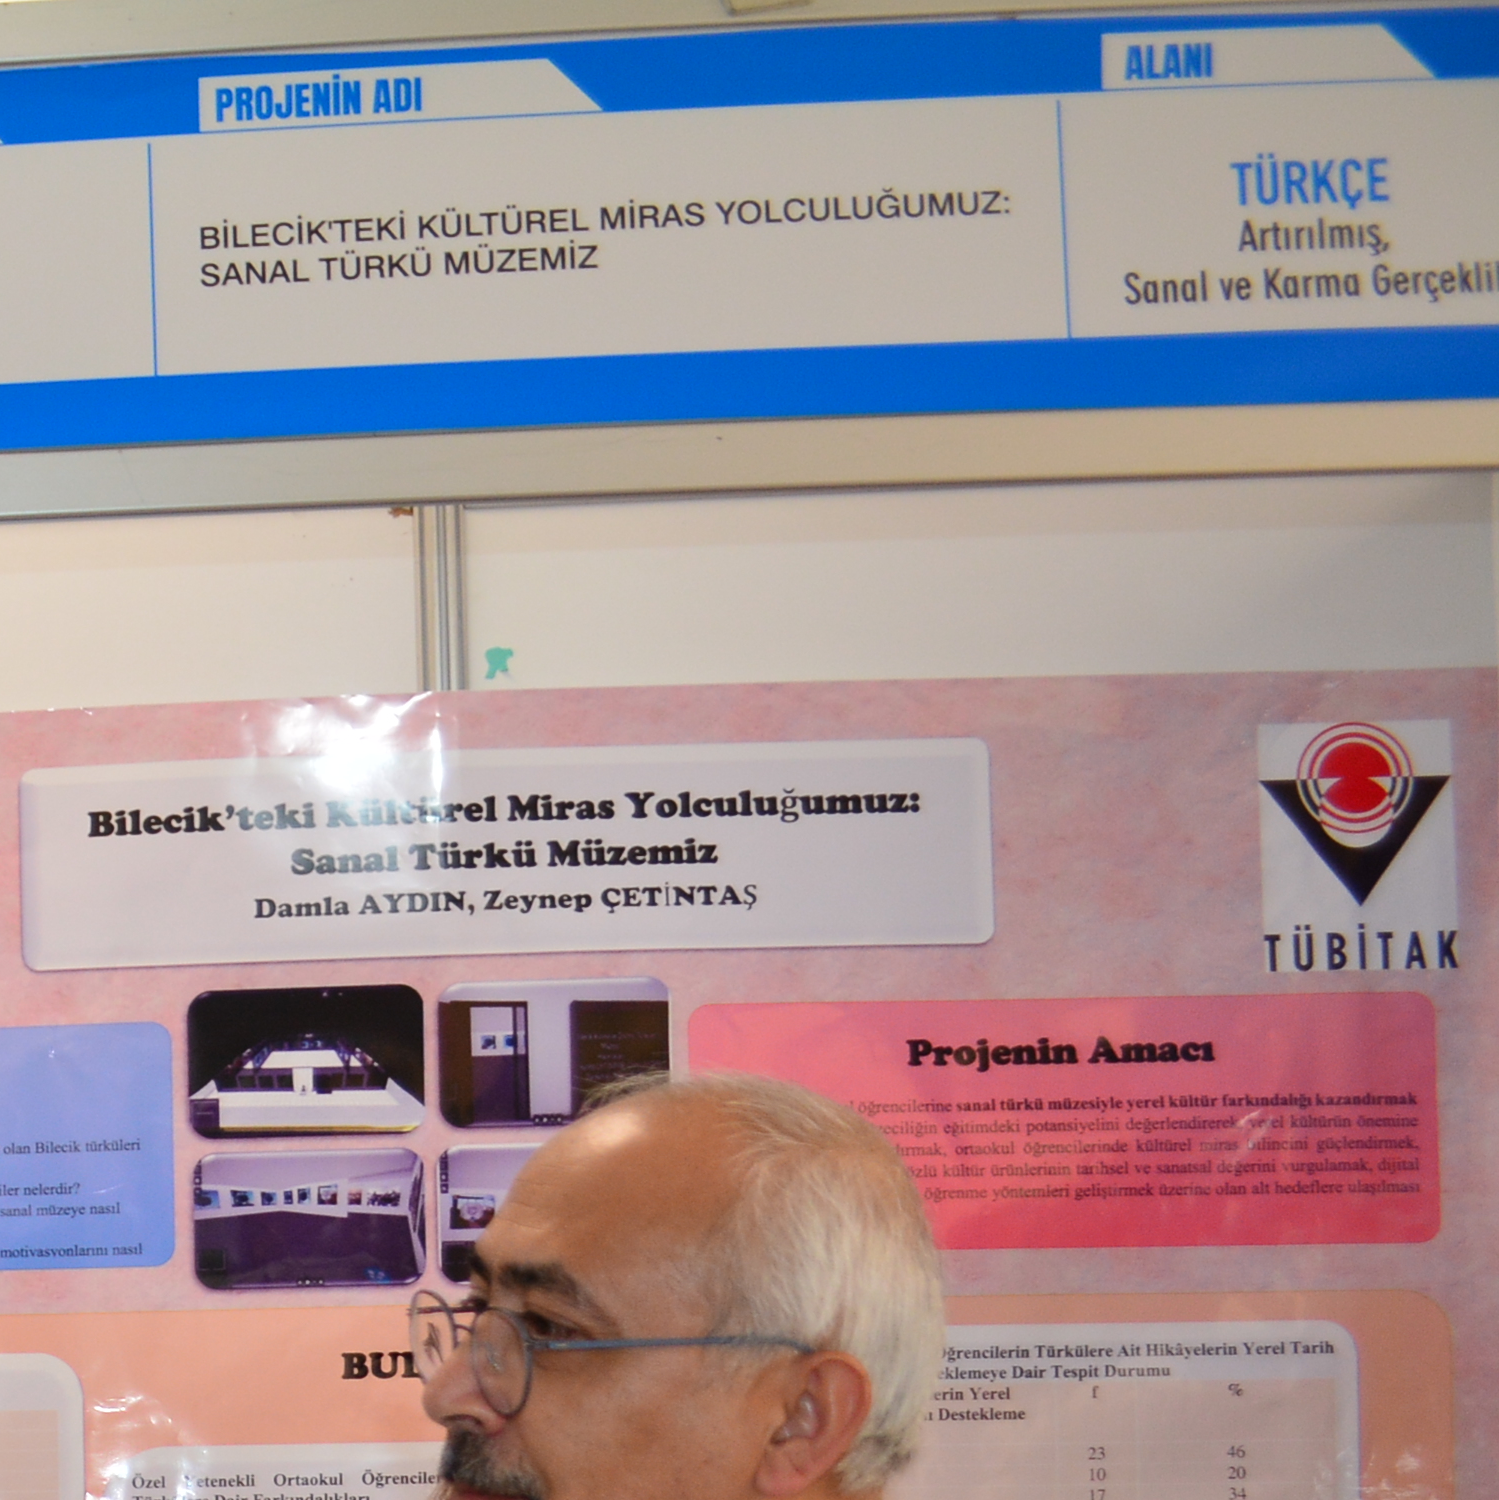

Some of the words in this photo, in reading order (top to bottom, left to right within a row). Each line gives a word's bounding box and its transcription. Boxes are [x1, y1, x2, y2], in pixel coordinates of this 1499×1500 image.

[1126, 43, 1213, 80] ALANI
[216, 74, 361, 122] PROJENİN
[374, 77, 422, 113] ADI
[1231, 153, 1390, 209] TÜRKÇE
[419, 205, 589, 238] KÜLTÜREL
[601, 200, 705, 230] MİRAS
[716, 188, 1009, 224] YOLCULUĞUMUZ:
[1239, 218, 1389, 256] Artırılmış,
[201, 260, 309, 287] SANAL
[319, 247, 431, 280] TÜRKÜ
[445, 240, 598, 275] MÜZEMİZ
[1125, 271, 1207, 305] Sanal
[1220, 277, 1251, 300] ve
[1264, 268, 1360, 299] Karma
[508, 795, 614, 821] Miras
[625, 789, 919, 822] Yolculuğumuz:
[291, 848, 399, 875] Sanal
[409, 841, 537, 871] Türkü
[547, 838, 718, 867] Müzemiz
[255, 897, 349, 918] Damla
[359, 891, 474, 915] AYDIN,
[484, 890, 592, 913] Zeynep
[601, 885, 756, 913] ÇETİNTAŞ
[1264, 923, 1458, 972] TÜBİTAK
[906, 1038, 1078, 1072] Projenin
[1088, 1037, 1215, 1063] Amacı
[1035, 1345, 1113, 1358] Türkülere
[1117, 1344, 1140, 1357] Ait
[1146, 1343, 1237, 1359] Hikâyelerin
[1243, 1342, 1285, 1355] Yerel
[1290, 1341, 1334, 1354] Tarih
